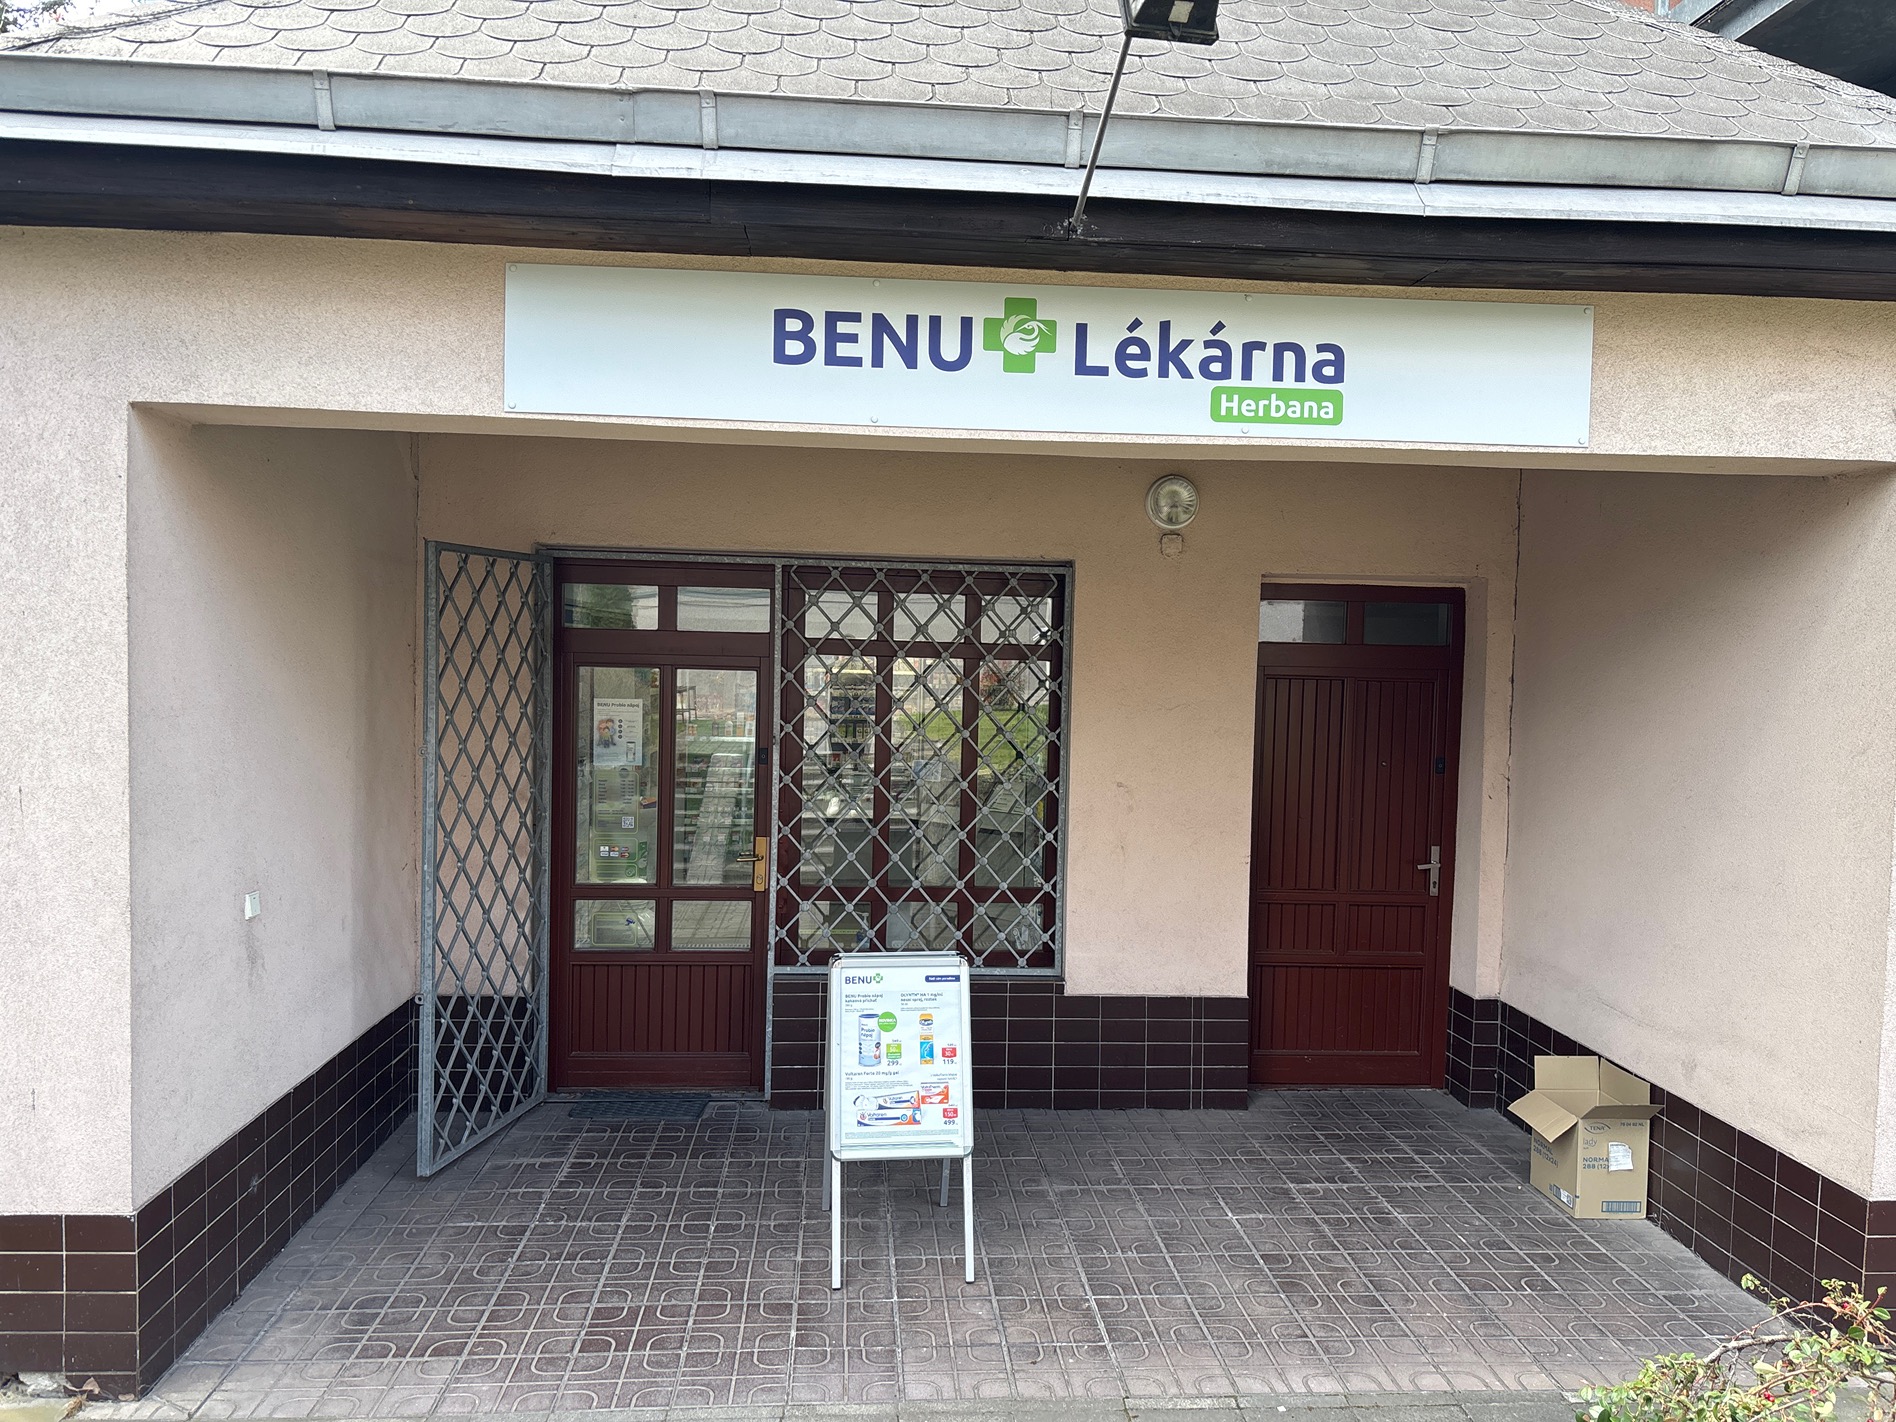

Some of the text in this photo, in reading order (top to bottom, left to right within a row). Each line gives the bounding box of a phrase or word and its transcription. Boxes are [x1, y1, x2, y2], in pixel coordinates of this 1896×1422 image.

[773, 308, 1346, 385] BENU Lékárna
[1219, 392, 1335, 420] Herbana
[845, 975, 872, 984] BENU
[1583, 1137, 1597, 1148] lady
